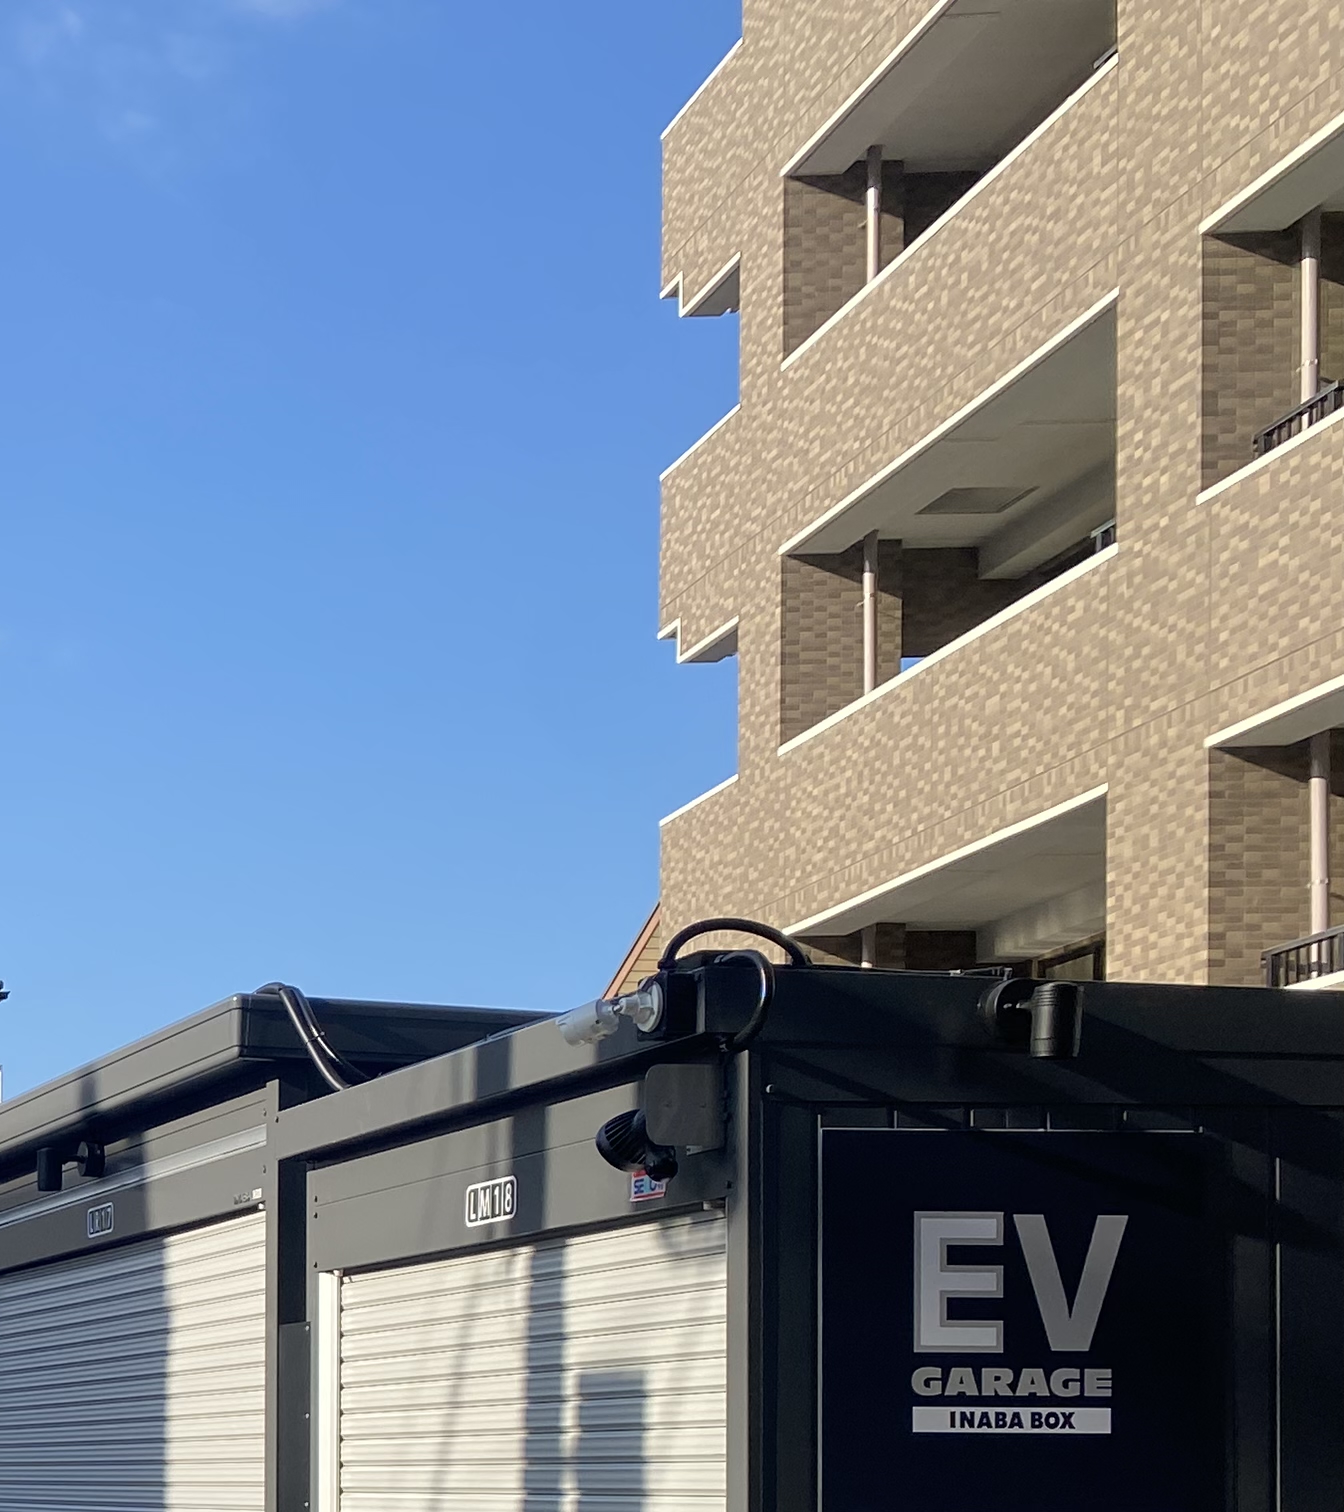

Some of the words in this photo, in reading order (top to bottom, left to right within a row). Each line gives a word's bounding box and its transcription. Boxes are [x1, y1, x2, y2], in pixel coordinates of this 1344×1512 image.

[469, 1182, 515, 1221] LM18
[913, 1211, 1129, 1353] EV
[911, 1366, 1113, 1398] GARAGE
[949, 1410, 1024, 1430] INABA
[1031, 1411, 1076, 1430] BOX
